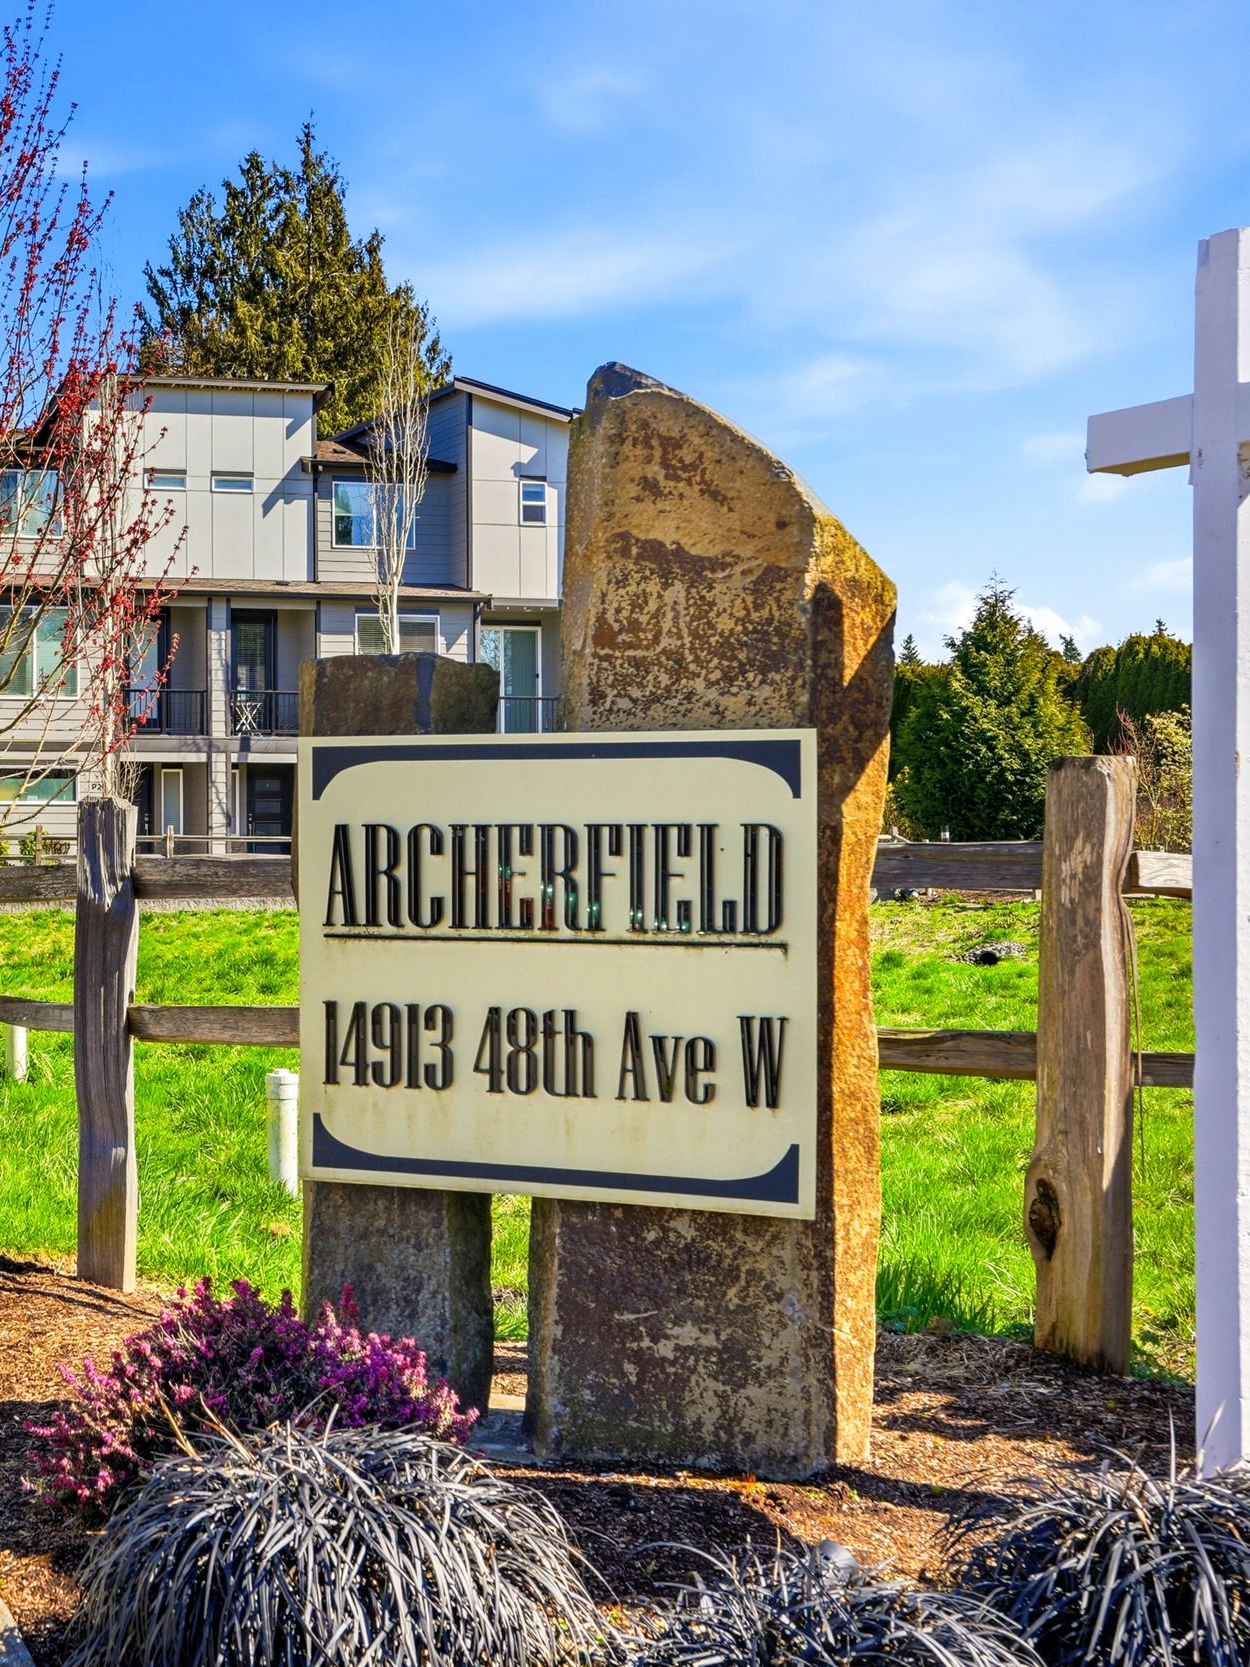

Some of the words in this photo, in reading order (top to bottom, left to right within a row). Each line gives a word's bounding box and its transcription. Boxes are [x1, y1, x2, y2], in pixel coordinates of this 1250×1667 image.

[322, 823, 784, 936] ARCHERFIELD
[322, 1000, 455, 1091] 14913
[473, 1006, 597, 1099] 48th
[615, 1011, 717, 1106] Ave
[736, 1016, 790, 1109] W
